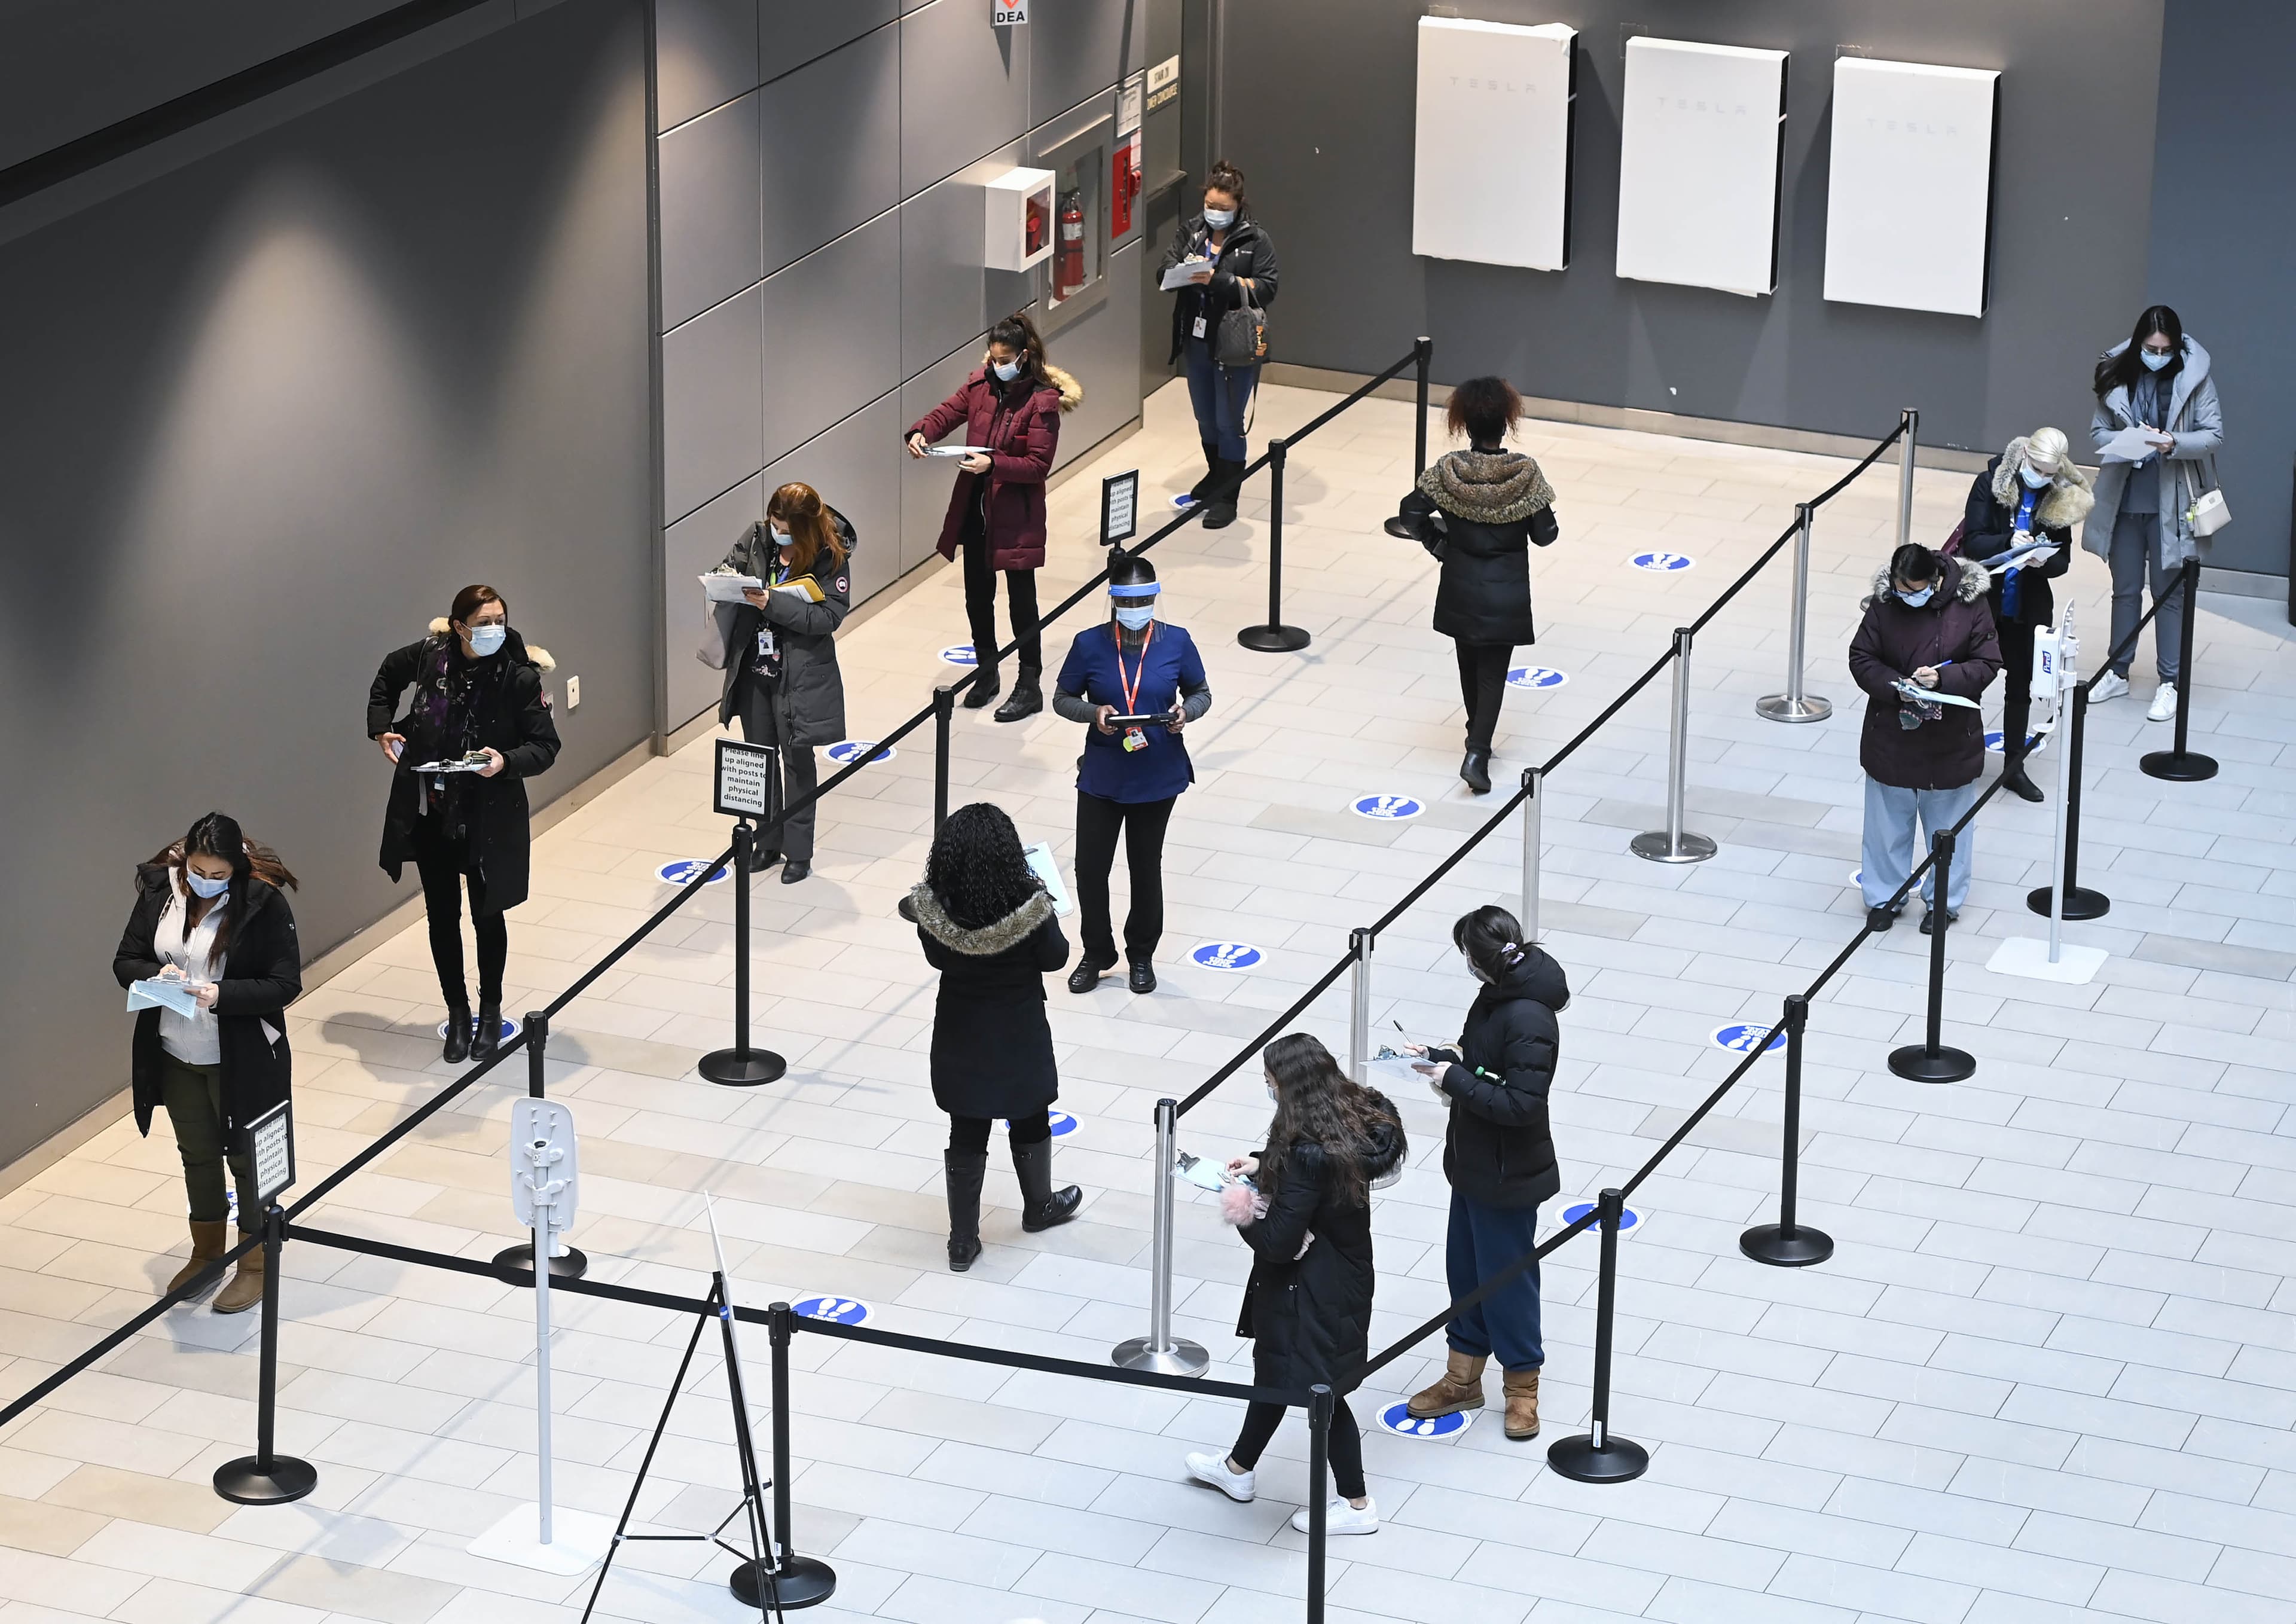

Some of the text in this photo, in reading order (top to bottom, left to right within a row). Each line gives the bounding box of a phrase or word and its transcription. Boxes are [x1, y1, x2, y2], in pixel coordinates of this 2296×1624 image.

[997, 11, 1025, 23] DEA
[1449, 76, 1535, 93] TESLA
[1657, 96, 1746, 115] TESLA
[722, 765, 736, 773] with
[736, 758, 764, 768] aligned
[727, 776, 760, 787] maintain
[728, 785, 758, 796] physical
[723, 793, 762, 807] distancing
[263, 1122, 283, 1143] aligned
[266, 1138, 280, 1153] posts
[259, 1147, 283, 1167] maintain
[260, 1156, 282, 1179] physical
